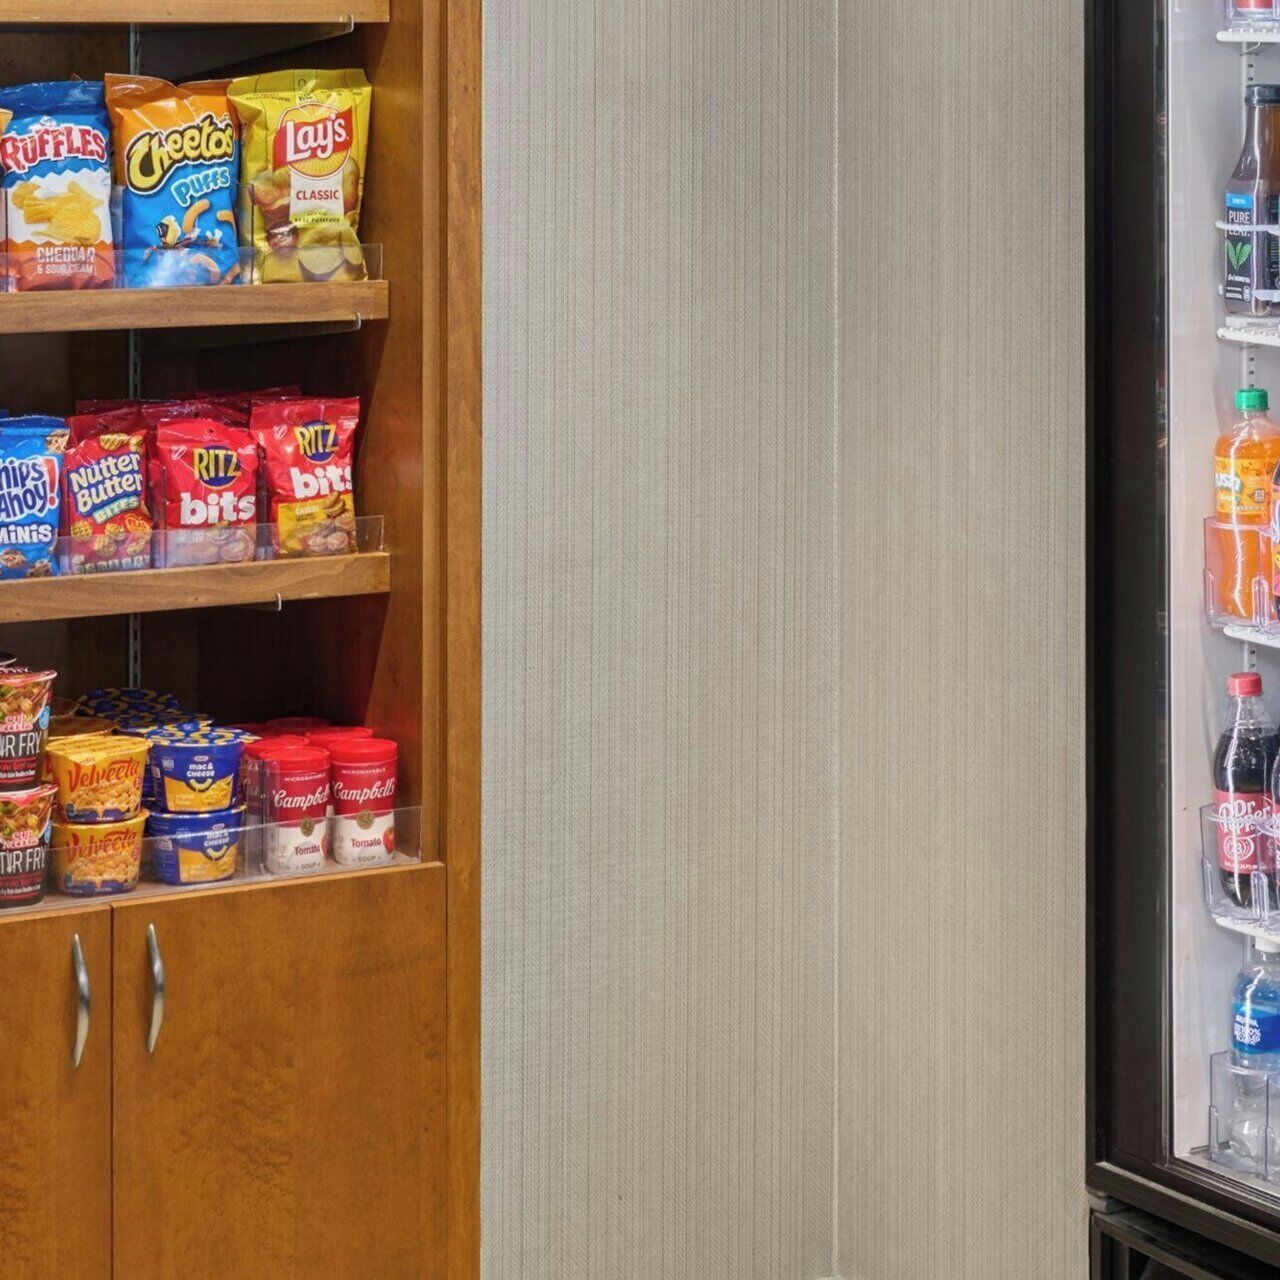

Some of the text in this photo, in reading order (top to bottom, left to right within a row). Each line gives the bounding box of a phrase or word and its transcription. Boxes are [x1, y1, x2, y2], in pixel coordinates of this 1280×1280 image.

[129, 118, 234, 191] Cheetos
[286, 118, 347, 162] Lay's
[296, 189, 339, 201] CLASSIC
[1228, 210, 1250, 223] PURE
[36, 245, 96, 264] CHEDDAR
[294, 424, 338, 456] RITZ
[70, 452, 140, 491] Nutter
[193, 450, 242, 481] RITZ
[76, 472, 143, 513] Butter
[180, 491, 255, 525] bits
[19, 732, 41, 755] FRY
[70, 759, 139, 790] Velveeta
[351, 839, 381, 848] Tomato
